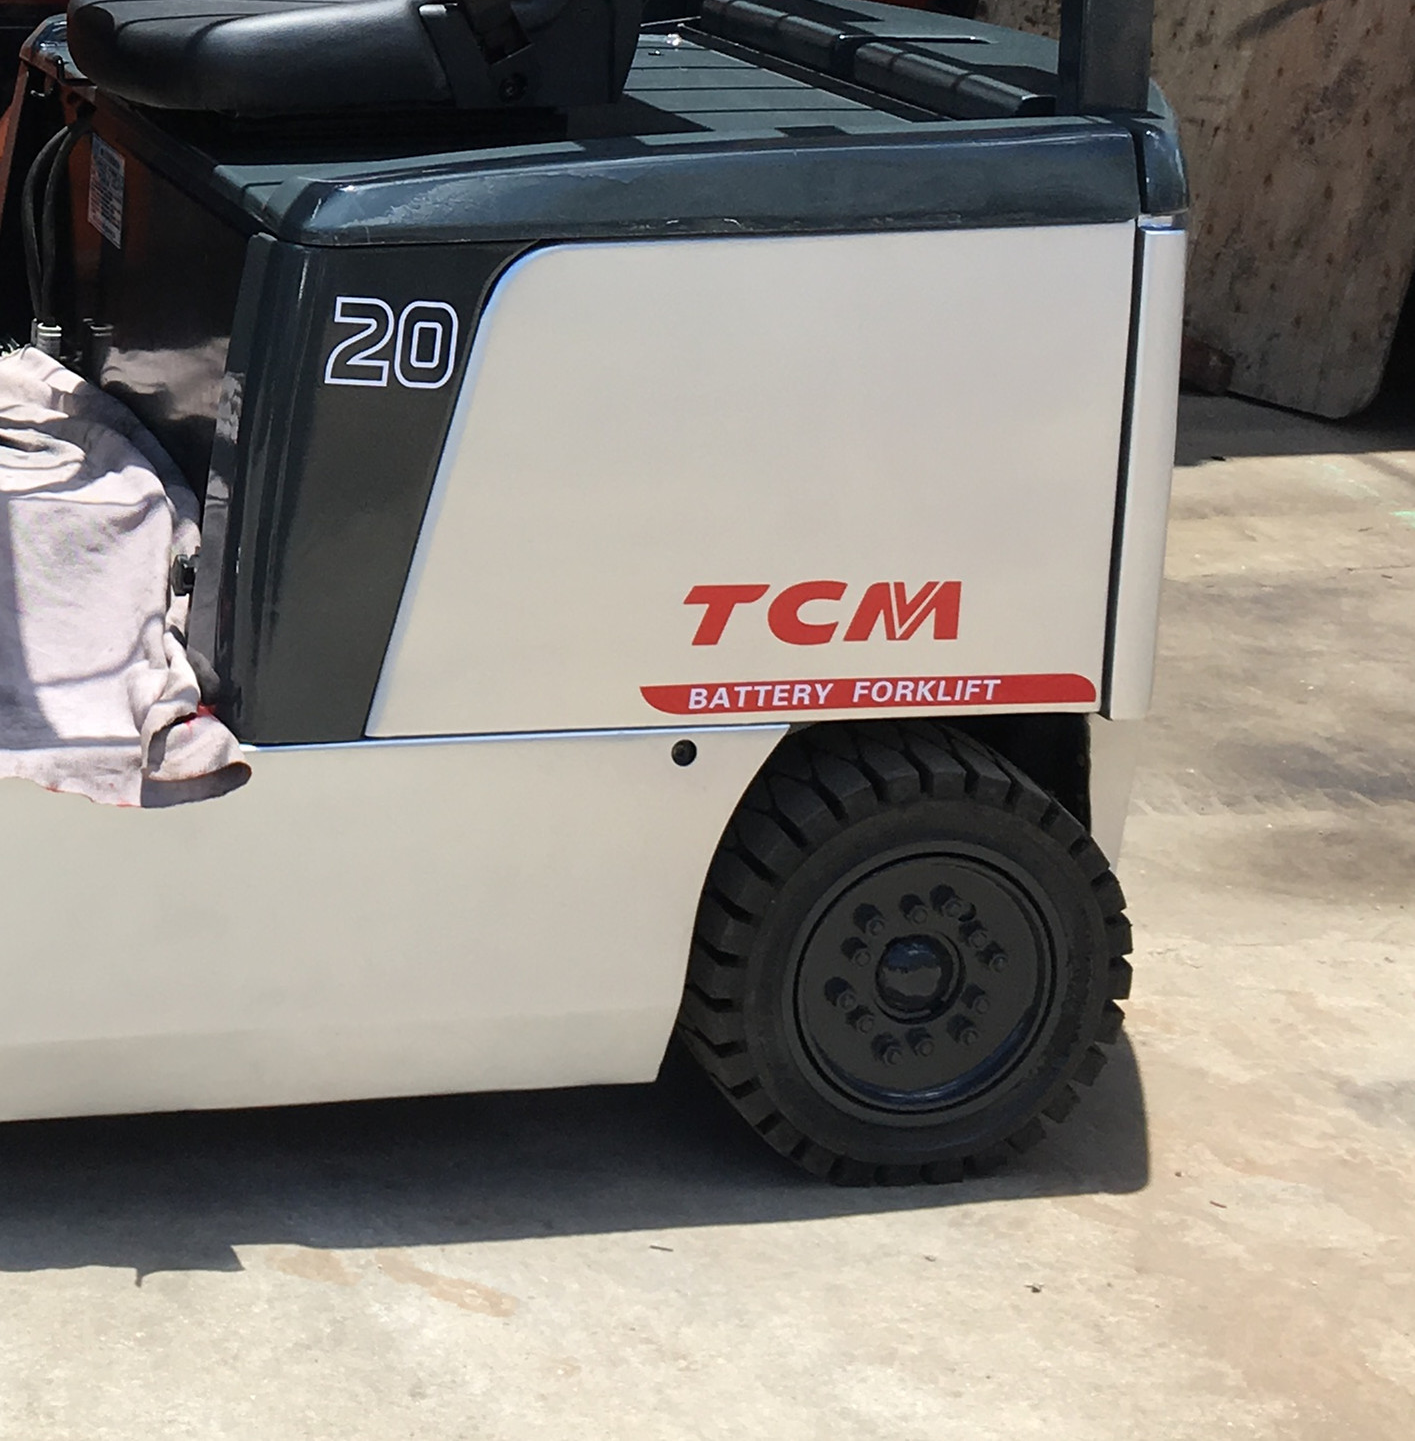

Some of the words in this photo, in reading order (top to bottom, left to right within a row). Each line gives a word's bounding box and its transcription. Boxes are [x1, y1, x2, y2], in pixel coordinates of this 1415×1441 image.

[324, 295, 458, 389] 20
[683, 580, 962, 646] TCM
[688, 682, 834, 711] BATTERY
[853, 678, 1002, 706] FORKLIFT
